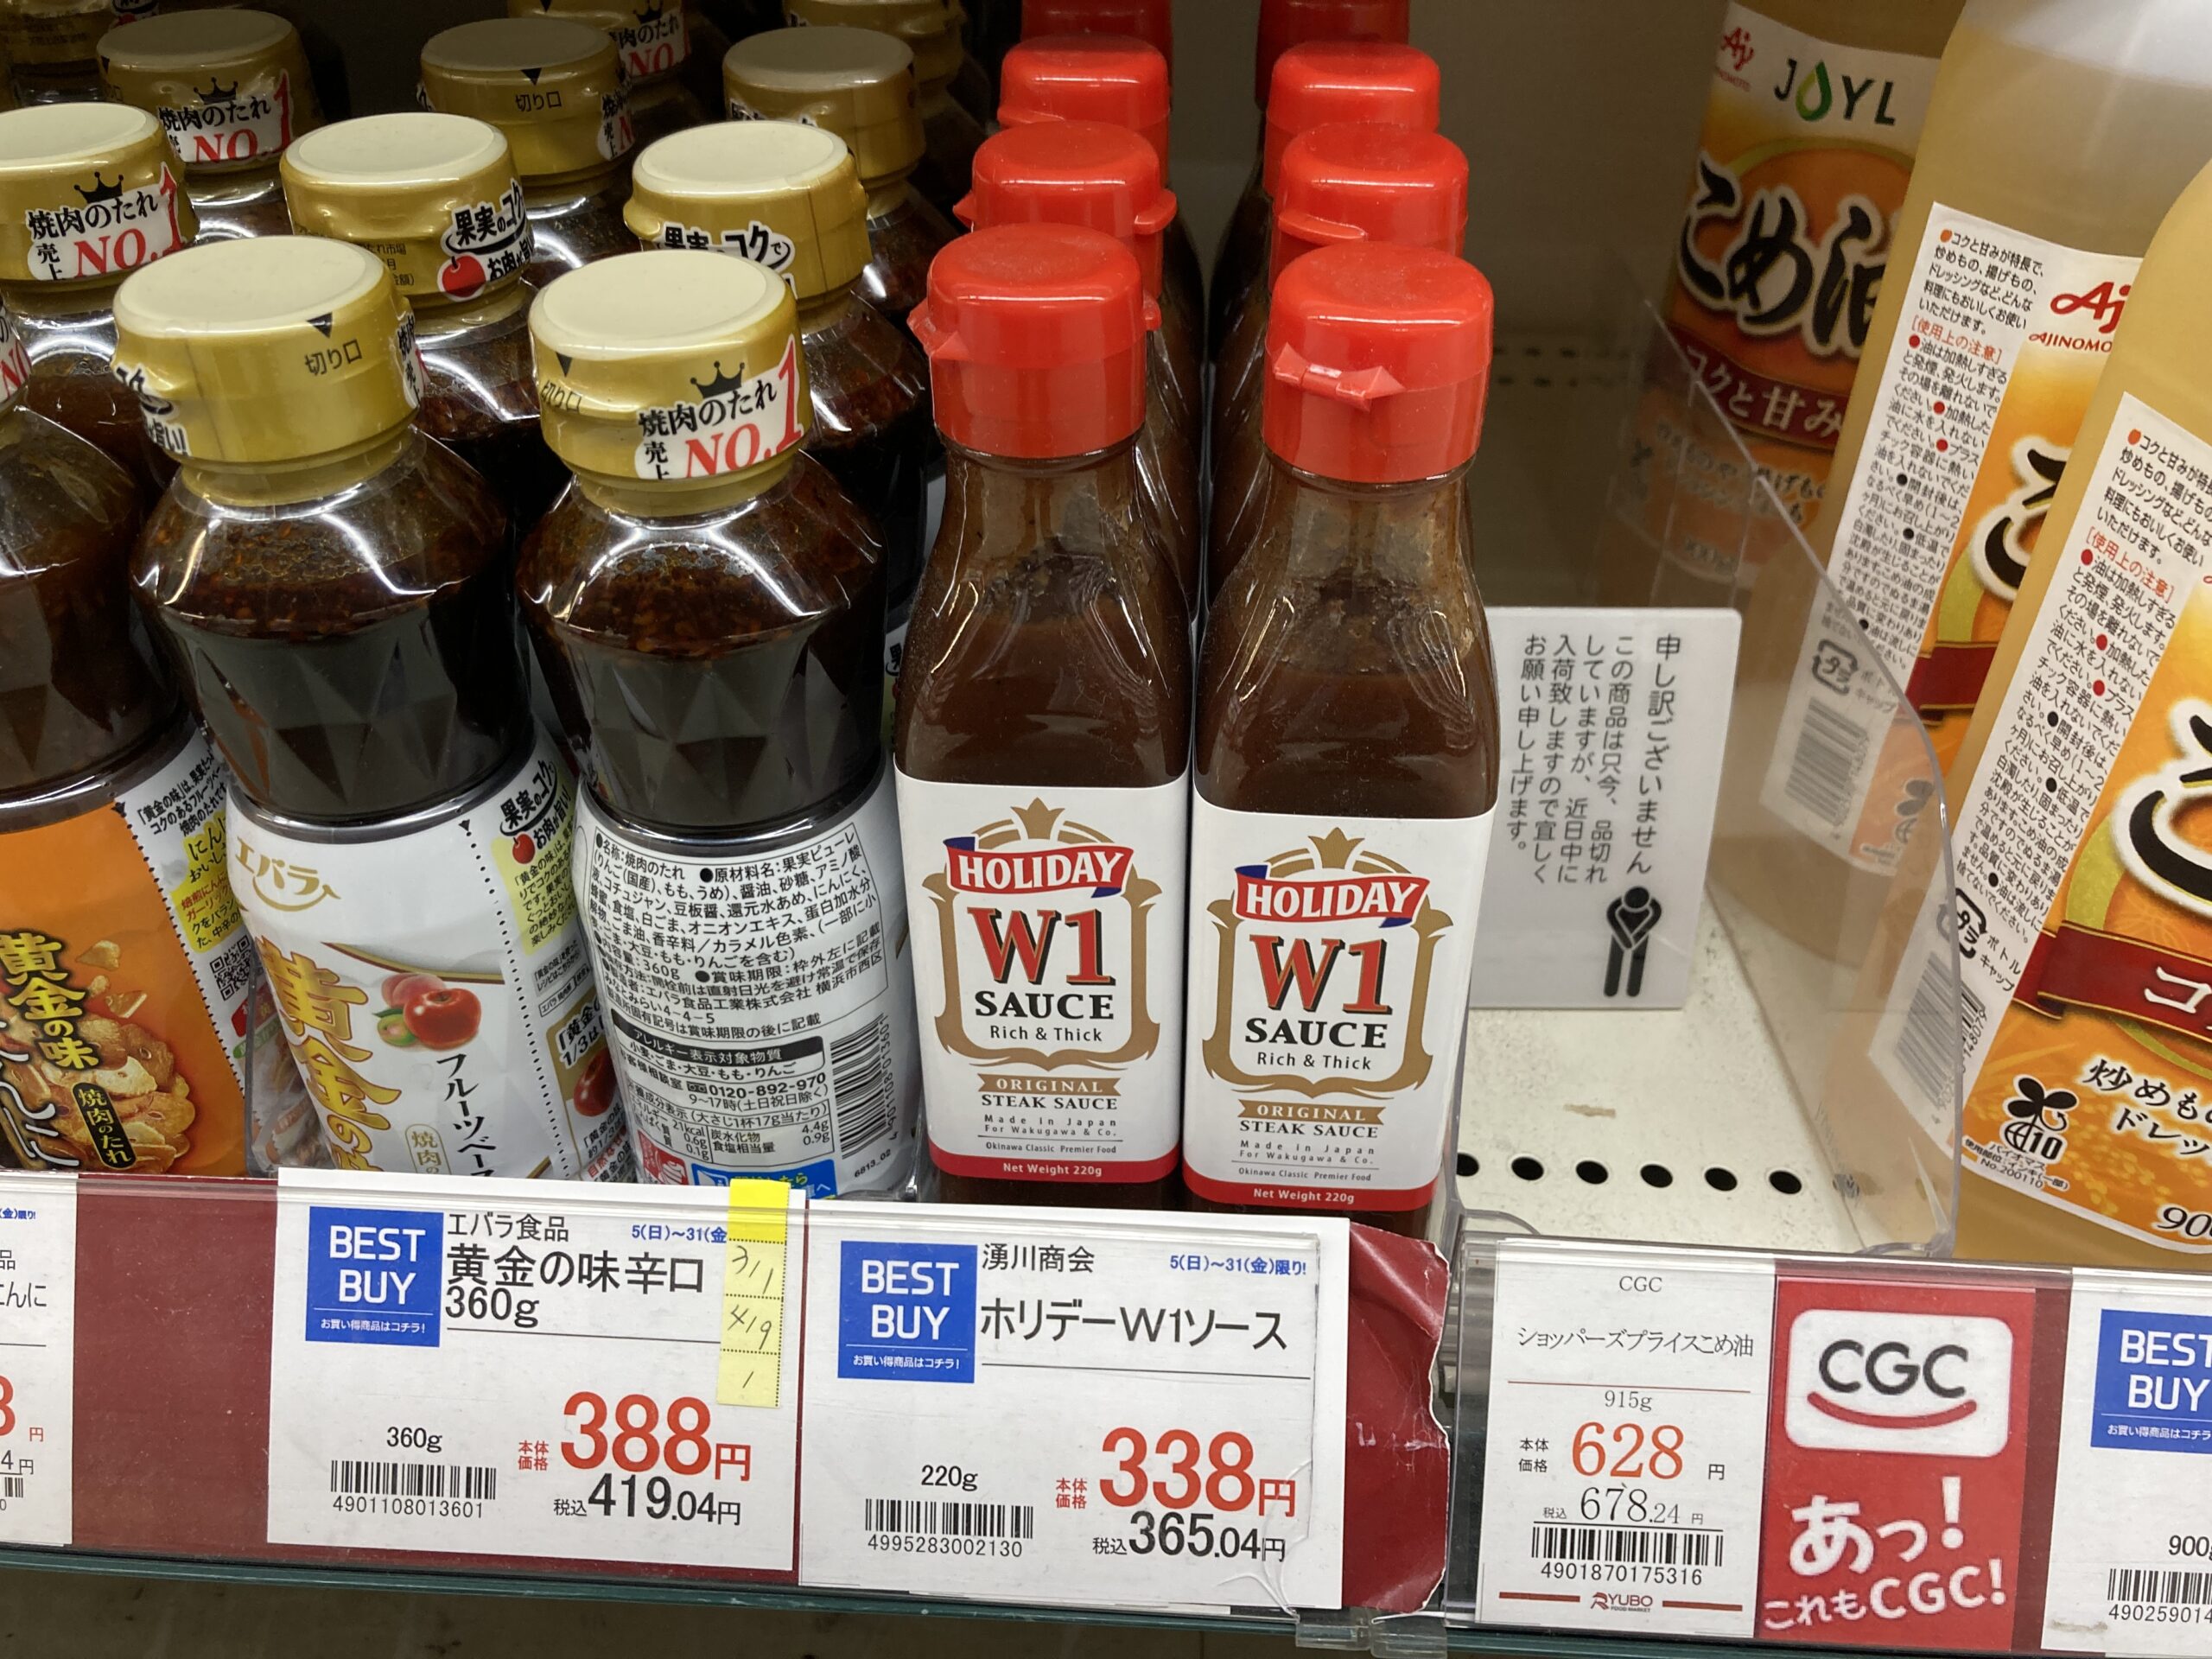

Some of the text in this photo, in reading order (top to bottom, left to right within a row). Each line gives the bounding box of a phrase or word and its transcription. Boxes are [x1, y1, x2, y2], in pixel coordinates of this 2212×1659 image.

[159, 93, 271, 132] 焼肉のたれ
[515, 89, 563, 113] 切り口
[29, 190, 158, 240] 焼肉のたれ
[74, 163, 184, 276] NO.1
[305, 339, 361, 376] 切り口
[638, 380, 777, 437] 焼肉のたれ
[685, 340, 800, 478] NO.1
[1506, 634, 1547, 851] お願い申し上げます。
[1626, 633, 1681, 875] 申し訳ございません
[1533, 634, 1576, 885] 入荷致しますので宜しく
[235, 836, 332, 899] エバラ
[959, 851, 1124, 890] HOLIDAY
[1246, 881, 1419, 918] HOLIDAY
[967, 907, 1116, 986] W1
[1249, 935, 1393, 1015] W1
[0, 933, 99, 1070] 黄金の味
[975, 991, 1115, 1020] SAUCE
[990, 1026, 1103, 1042] Rich & Thick
[1244, 1018, 1388, 1048] SAUCE
[1258, 1052, 1372, 1071] Rich & Thick
[996, 1077, 1103, 1093] ORIGINAL
[981, 1093, 1118, 1110] STEAK SAUCE
[1257, 1104, 1366, 1122] ORIGINAL
[78, 1088, 131, 1164] 焼肉のたれ
[984, 1115, 1027, 1125] Made
[1067, 1117, 1116, 1128] Japan
[985, 1124, 1005, 1133] For
[1240, 1120, 1379, 1139] STEAK SAUCE
[986, 1142, 1117, 1154] Okinawa Classic Premier Food
[1240, 1141, 1283, 1151] Made
[1325, 1145, 1375, 1155] Japan
[1240, 1150, 1258, 1159] For
[1002, 1162, 1103, 1177] Net Weight 220g
[1238, 1167, 1372, 1182] Okinawa Classic Premier Food
[1253, 1188, 1355, 1205] Net Weight 220g
[448, 1212, 569, 1243] エバラ食品
[2157, 1206, 2212, 1237] 90
[329, 1225, 426, 1262] BEST
[982, 1243, 1095, 1274] 湧川商会
[447, 1243, 704, 1294] 黄金の味辛口
[862, 1261, 959, 1296] BEST
[340, 1271, 416, 1305] BUY
[1619, 1275, 1663, 1294] CGC
[445, 1287, 540, 1328] 360g
[872, 1305, 950, 1340] BUY
[320, 1318, 426, 1334] お買い得商品はコチラ!
[981, 1297, 1288, 1351] ホリデーW1ソース
[1518, 1327, 1754, 1357] ショッパーズプライスこめ油
[2120, 1329, 2212, 1369] BEST
[853, 1354, 960, 1370] お買い得商品はコチラ!
[1819, 1339, 1968, 1398] CGC
[1605, 1389, 1652, 1412] 915g
[2128, 1375, 2210, 1412] BUY
[29, 1427, 44, 1442] 円
[386, 1427, 443, 1452] 360g
[518, 1440, 549, 1457] 本体
[1519, 1437, 1549, 1452] 本体
[518, 1456, 548, 1471] 価格
[1518, 1458, 1548, 1472] 価格
[1572, 1421, 1726, 1480] 628 円
[921, 1465, 979, 1492] 220g
[1056, 1478, 1087, 1494] 本体
[333, 1495, 484, 1519] 4901108013601
[1055, 1493, 1087, 1510] 価格
[1543, 1507, 1567, 1520] 税込
[1580, 1487, 1681, 1524] 678.24
[868, 1535, 1023, 1558] 4995283002130
[2168, 1535, 2212, 1560] 900
[1541, 1561, 1702, 1586] 4901870175316
[1764, 1559, 2006, 1630] これもCGC!
